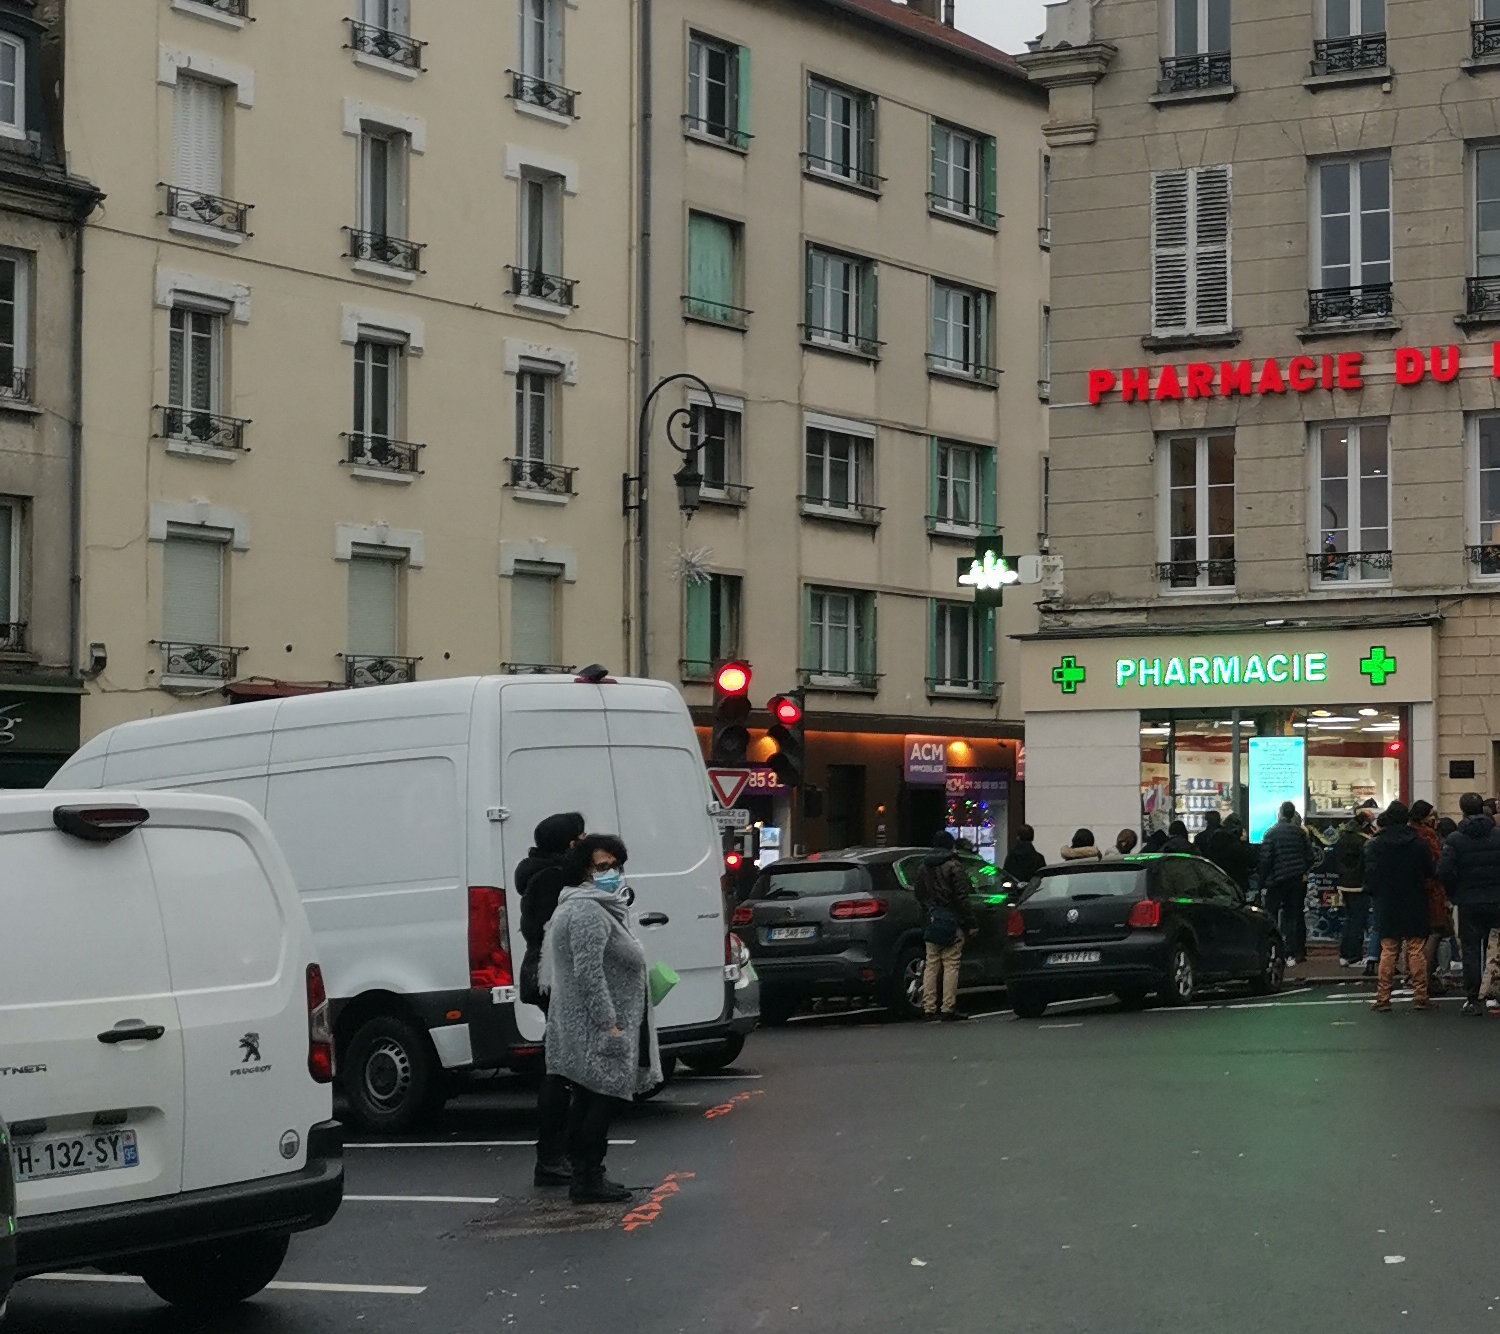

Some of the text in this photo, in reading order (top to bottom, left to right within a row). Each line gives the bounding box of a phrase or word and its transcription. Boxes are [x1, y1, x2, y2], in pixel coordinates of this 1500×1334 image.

[1088, 352, 1364, 405] PHARMACIE
[1395, 344, 1461, 385] DU
[1115, 651, 1327, 688] PHARMACIE
[909, 742, 944, 762] ACM
[229, 1064, 272, 1077] PEUGEOT
[12, 1134, 121, 1175] H-132-SY
